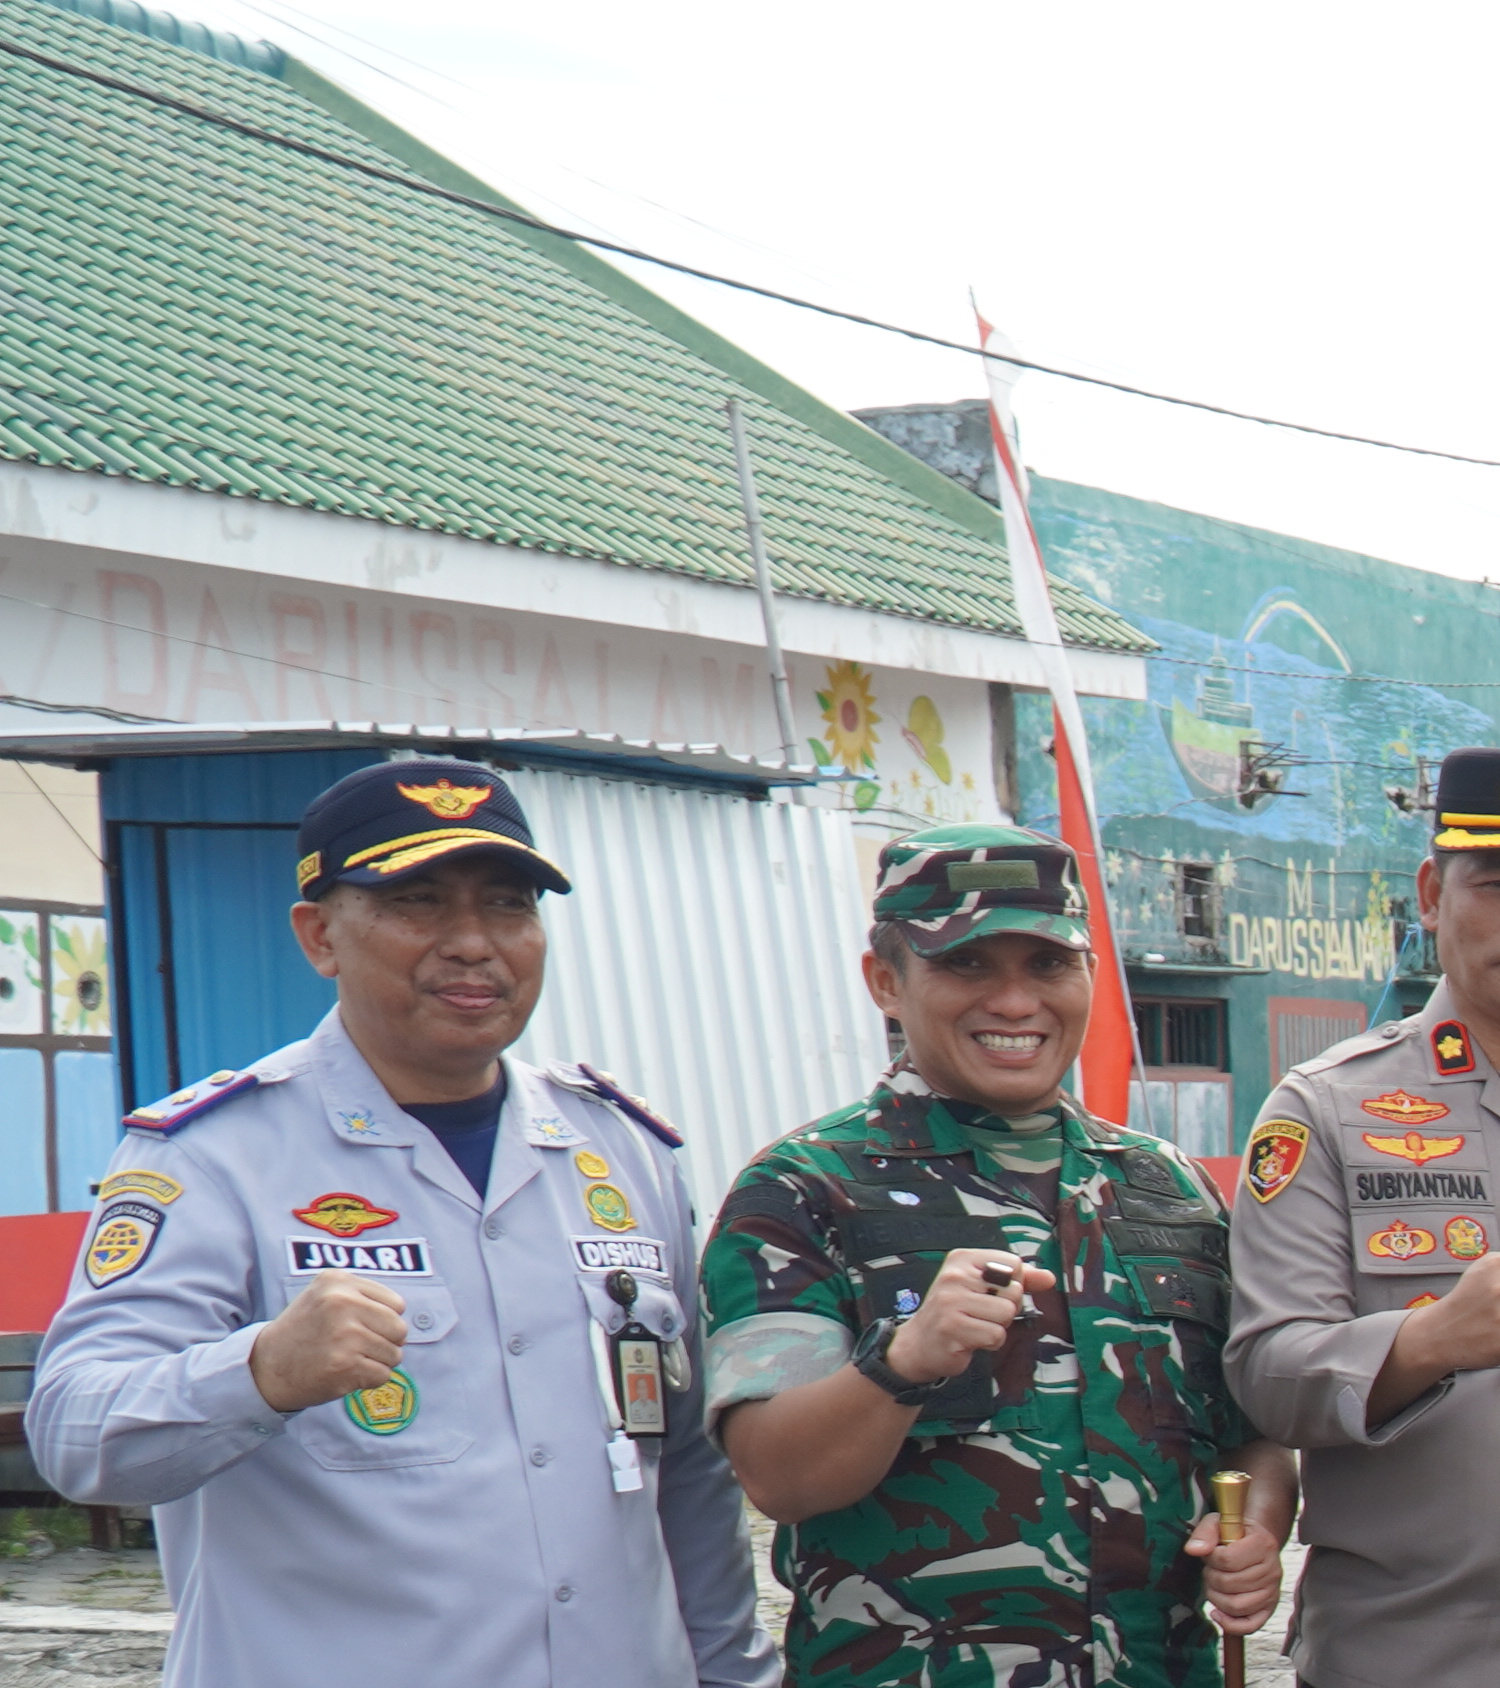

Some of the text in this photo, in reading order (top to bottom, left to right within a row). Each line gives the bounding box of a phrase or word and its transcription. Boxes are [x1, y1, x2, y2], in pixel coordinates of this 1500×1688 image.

[1356, 1171, 1488, 1201] SUBIYANTANA
[306, 1243, 414, 1270] JUARI
[582, 1241, 660, 1270] DISHUB
